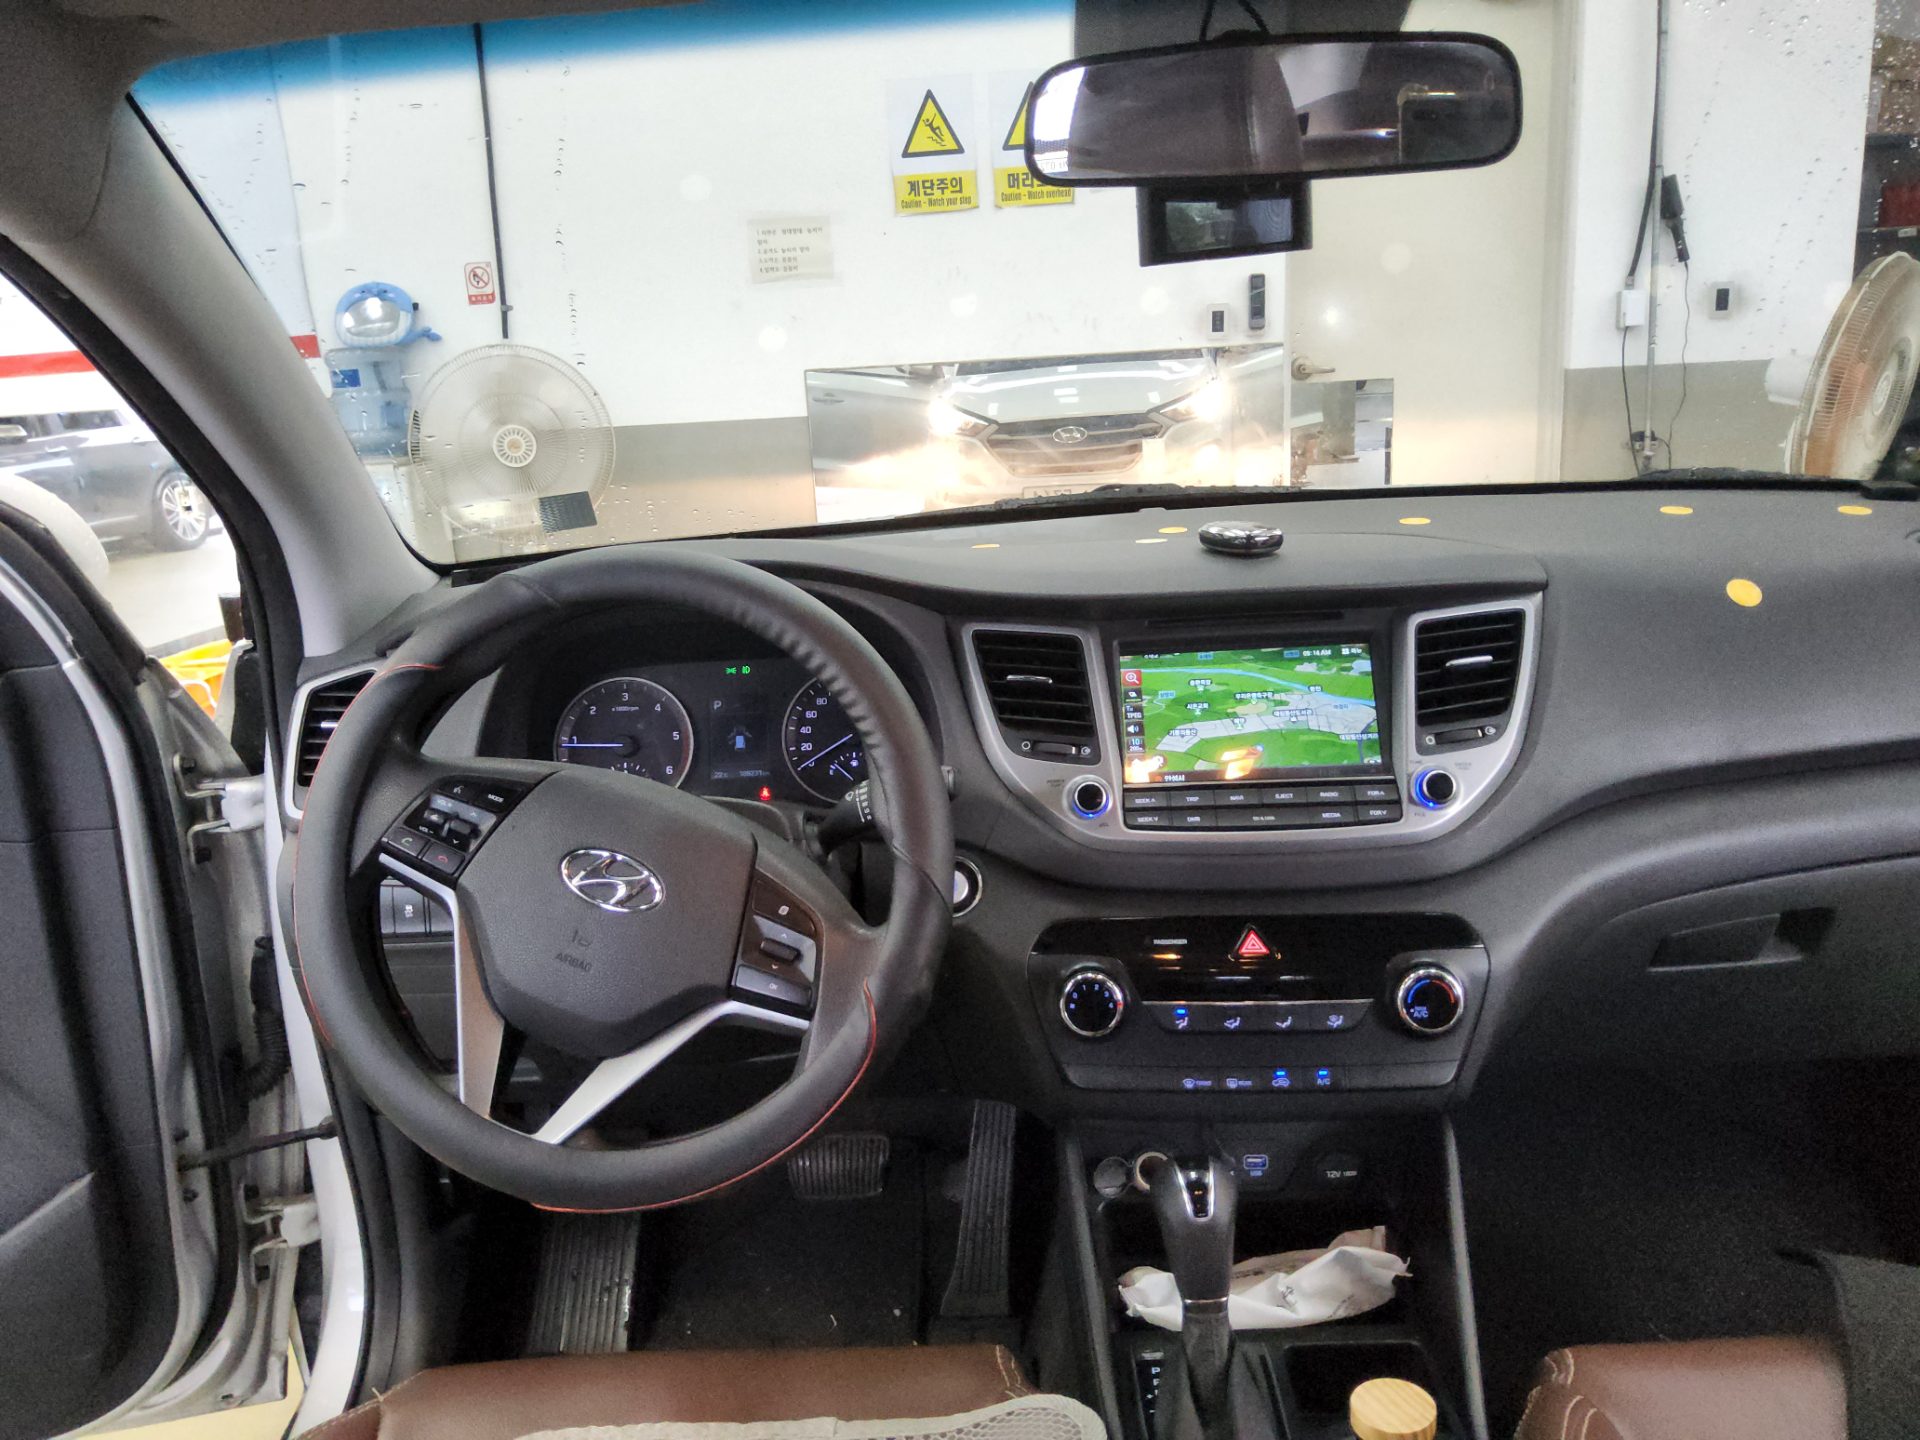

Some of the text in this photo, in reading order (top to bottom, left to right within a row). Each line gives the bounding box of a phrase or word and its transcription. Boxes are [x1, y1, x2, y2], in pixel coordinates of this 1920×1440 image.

[907, 176, 963, 197] 계단주의
[1001, 192, 1022, 202] Caution
[1028, 189, 1044, 200] Watch
[1046, 188, 1072, 199] overhead
[901, 199, 922, 209] Caution
[928, 197, 945, 207] Watch
[946, 197, 958, 207] your
[960, 196, 972, 205] step
[621, 692, 629, 702] 3
[816, 697, 828, 706] 80
[654, 703, 661, 712] 4
[713, 700, 722, 710] P
[589, 706, 597, 715] 2
[805, 710, 818, 719] 60
[799, 725, 812, 734] 40
[571, 736, 578, 744] 1
[672, 731, 680, 741] 5
[1131, 737, 1140, 746] 10
[800, 742, 813, 751] 20
[665, 765, 674, 775] 6
[487, 793, 505, 803] MODE
[418, 825, 429, 833] VOL
[555, 953, 592, 971] AIRBAG
[1094, 983, 1100, 991] 2
[1316, 1078, 1331, 1086] A/C
[1325, 1170, 1341, 1178] 12V
[1151, 1366, 1161, 1375] P
